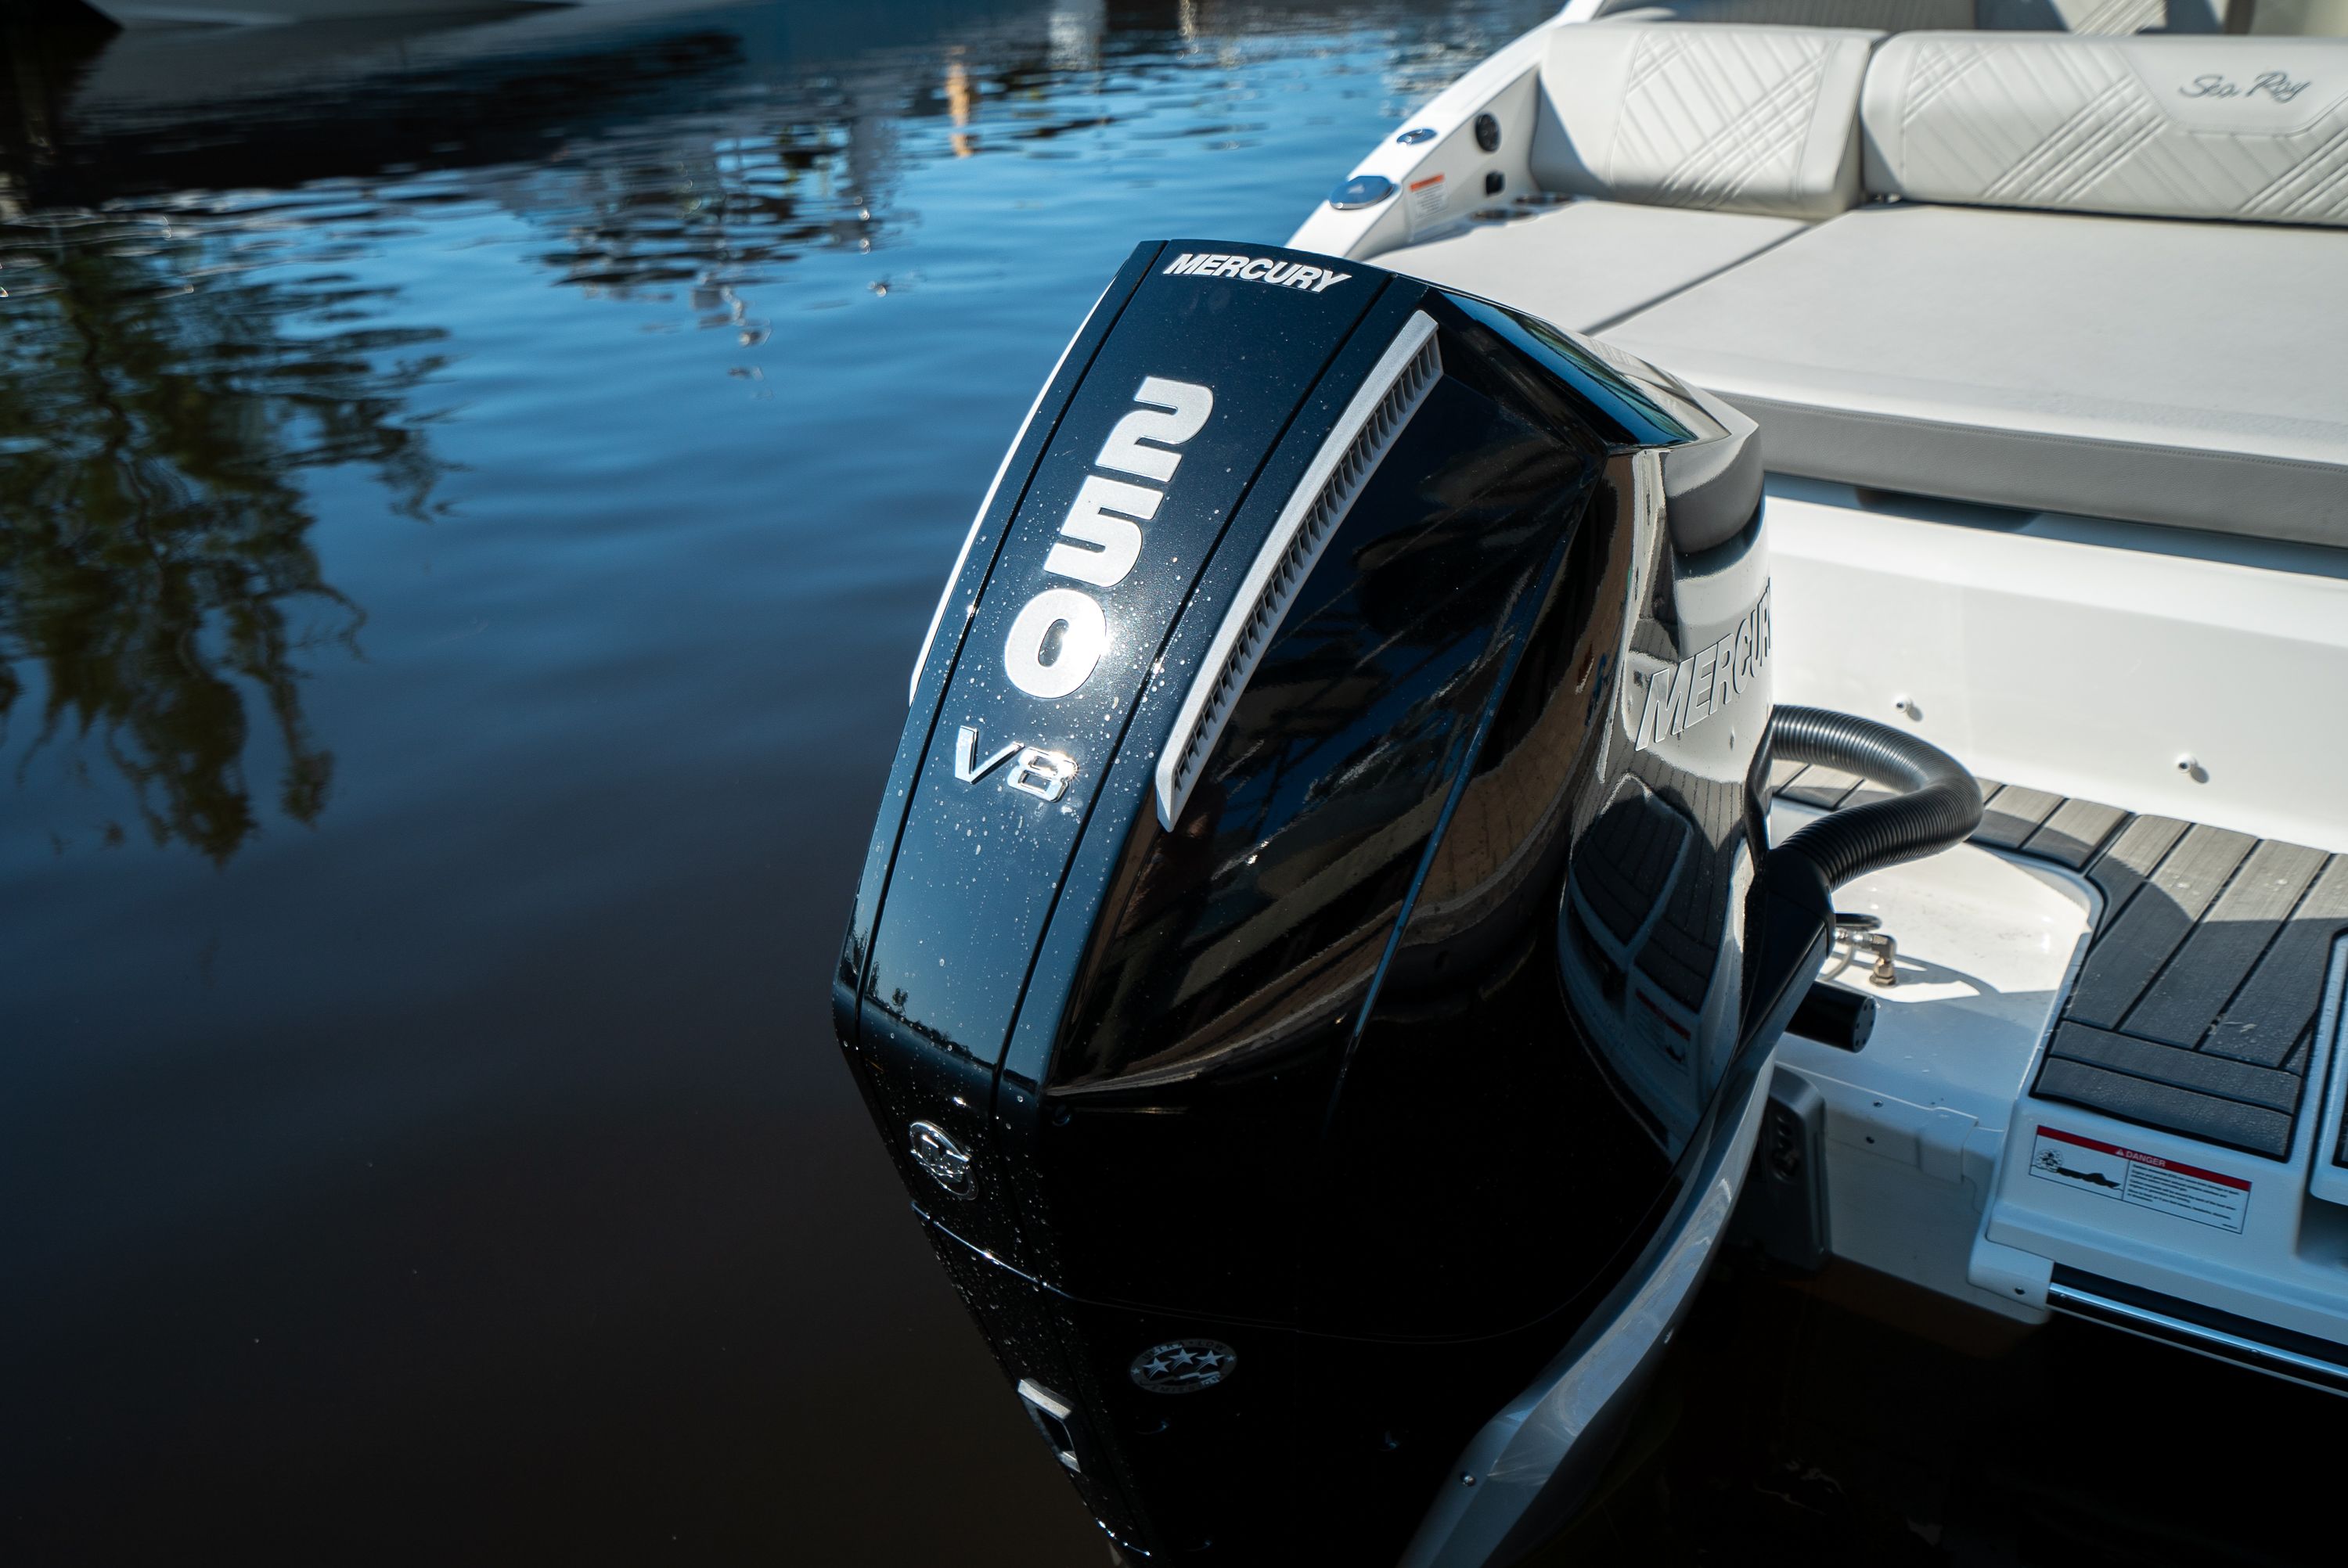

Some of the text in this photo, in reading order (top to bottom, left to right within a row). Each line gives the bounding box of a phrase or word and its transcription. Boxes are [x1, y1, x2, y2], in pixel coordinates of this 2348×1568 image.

[2178, 70, 2311, 104] Sea Ray
[1162, 253, 1352, 293] MERCURY
[1004, 376, 1214, 699] 250
[1635, 577, 1771, 752] MERCUR
[954, 725, 1077, 803] V8
[2126, 1150, 2166, 1167] DANGER
